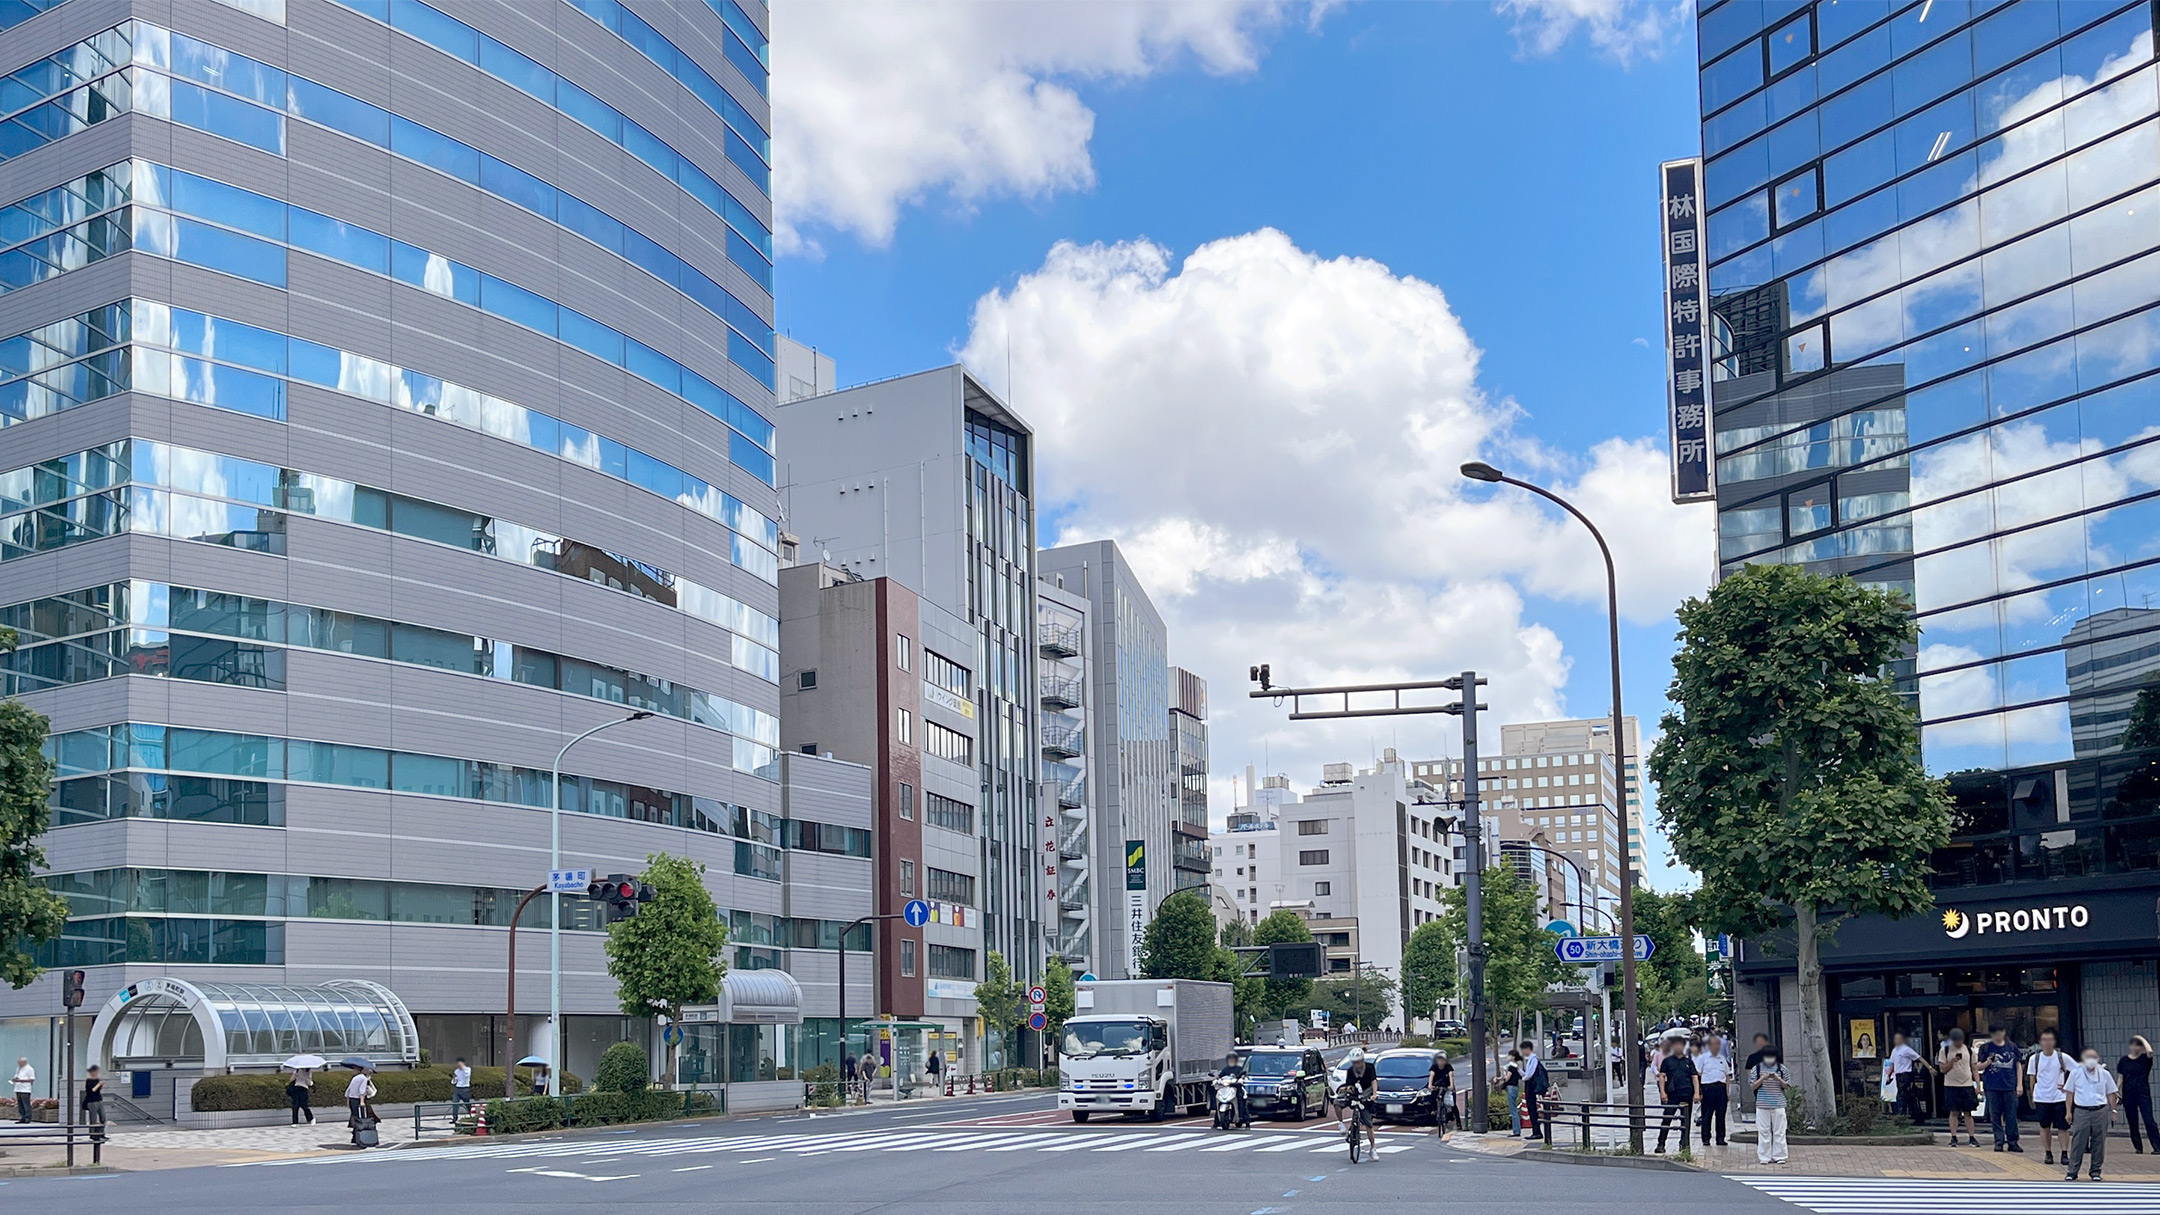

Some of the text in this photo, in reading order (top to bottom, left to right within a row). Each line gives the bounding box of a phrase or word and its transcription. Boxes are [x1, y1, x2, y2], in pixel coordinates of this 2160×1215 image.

[1669, 194, 1705, 464] 林国際特許事務所
[1045, 816, 1056, 900] 立花証券
[554, 882, 584, 890] Kayabacho
[1976, 905, 2088, 934] PRONTO
[1569, 945, 1581, 955] 50
[1586, 939, 1642, 952] 新大橋り
